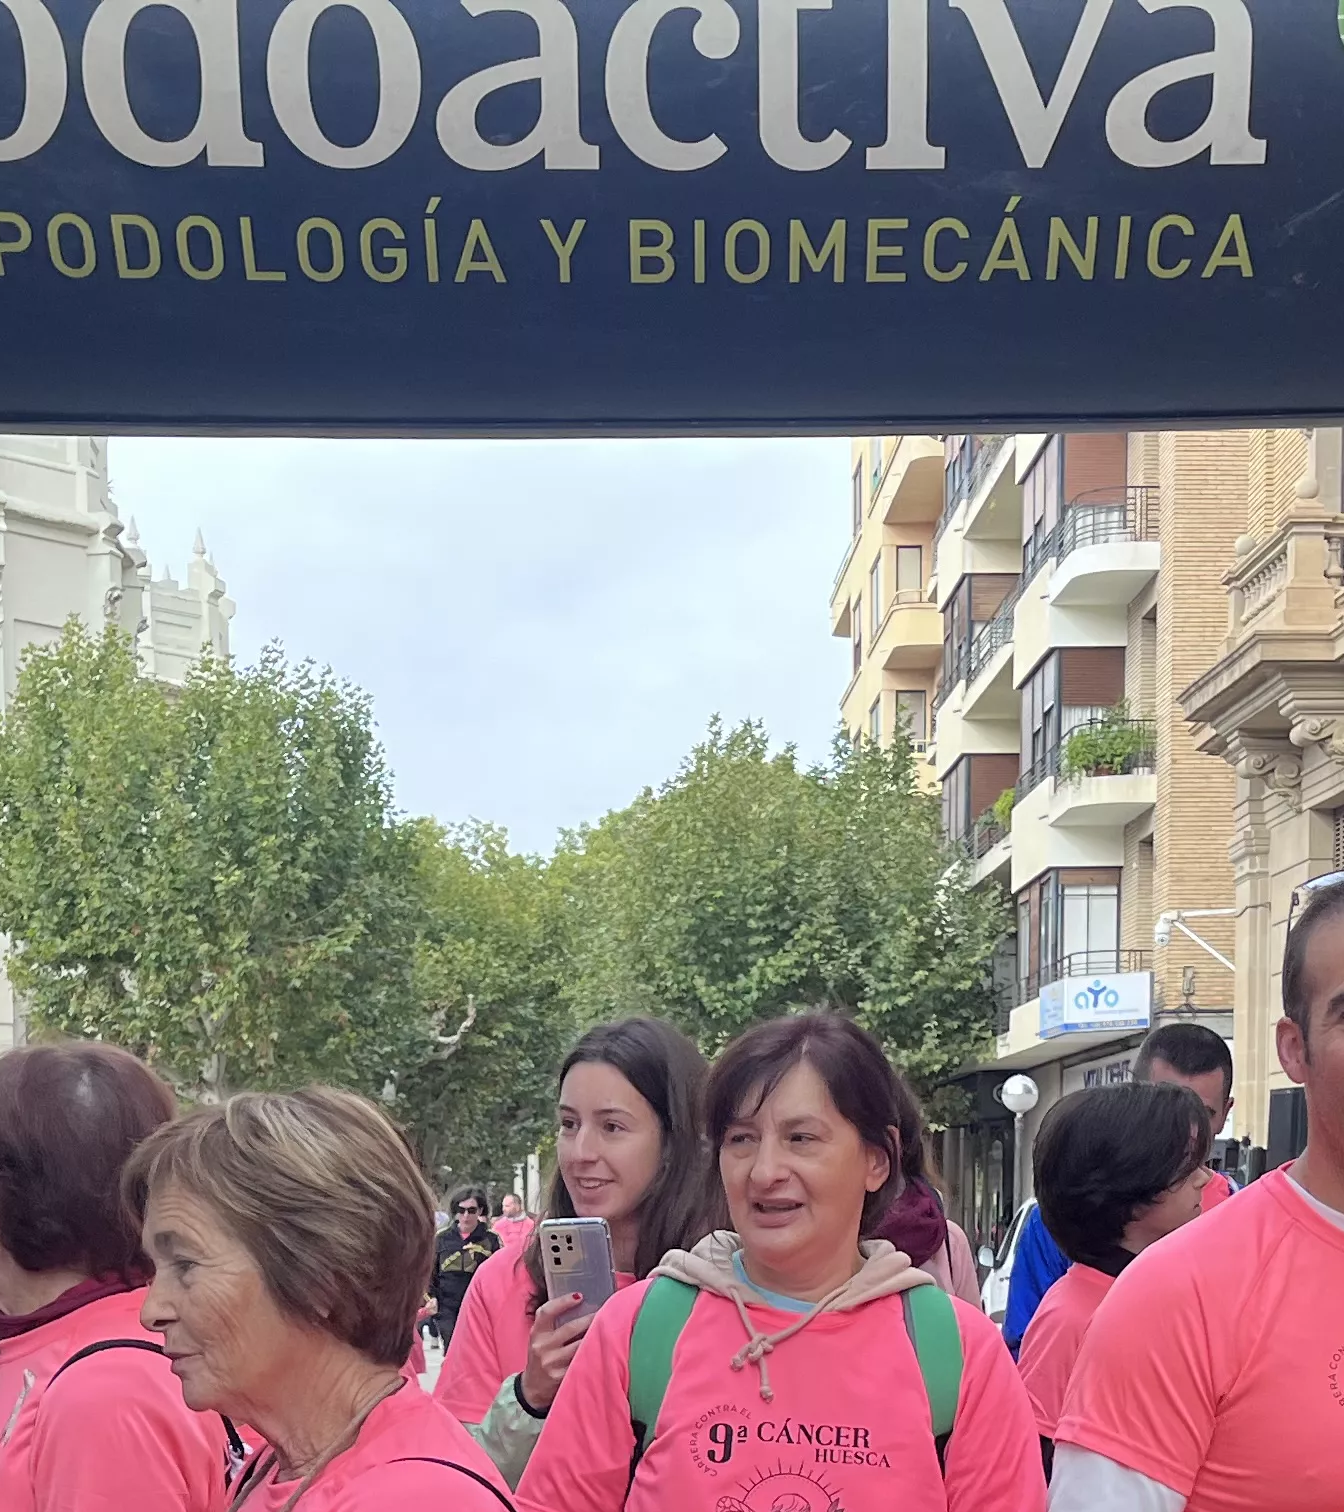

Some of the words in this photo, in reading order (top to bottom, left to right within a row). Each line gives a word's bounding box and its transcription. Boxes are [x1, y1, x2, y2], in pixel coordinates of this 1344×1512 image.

[539, 218, 587, 284] Y
[628, 195, 1254, 285] BIOMECÁNICA
[695, 1404, 738, 1430] CONTRA
[757, 1418, 870, 1449] CÁNCER
[815, 1448, 891, 1468] HUESCA
